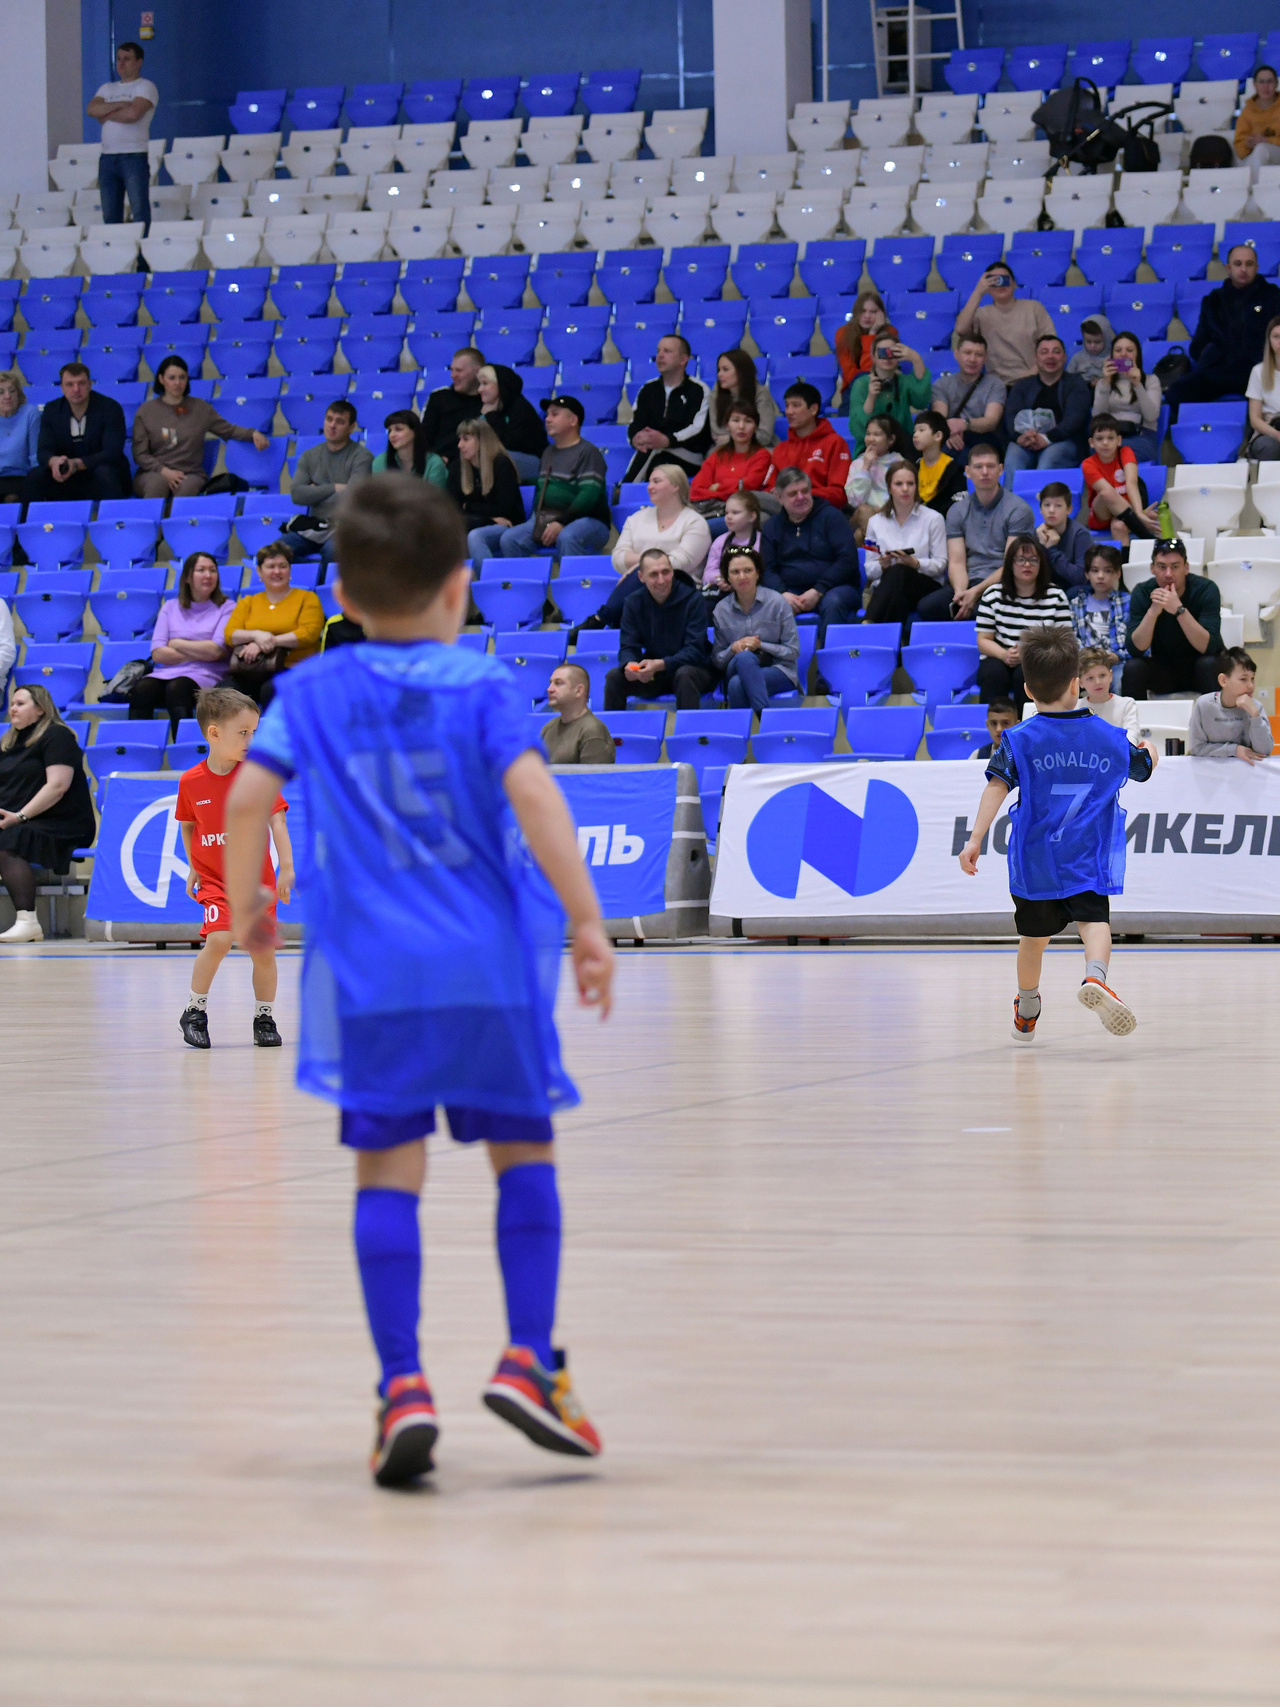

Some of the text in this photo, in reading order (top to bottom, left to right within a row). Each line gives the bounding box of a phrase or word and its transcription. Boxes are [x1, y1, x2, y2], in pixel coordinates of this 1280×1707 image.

[1032, 751, 1111, 774] RONALDO
[1049, 783, 1094, 842] 7
[201, 832, 229, 847] АРК
